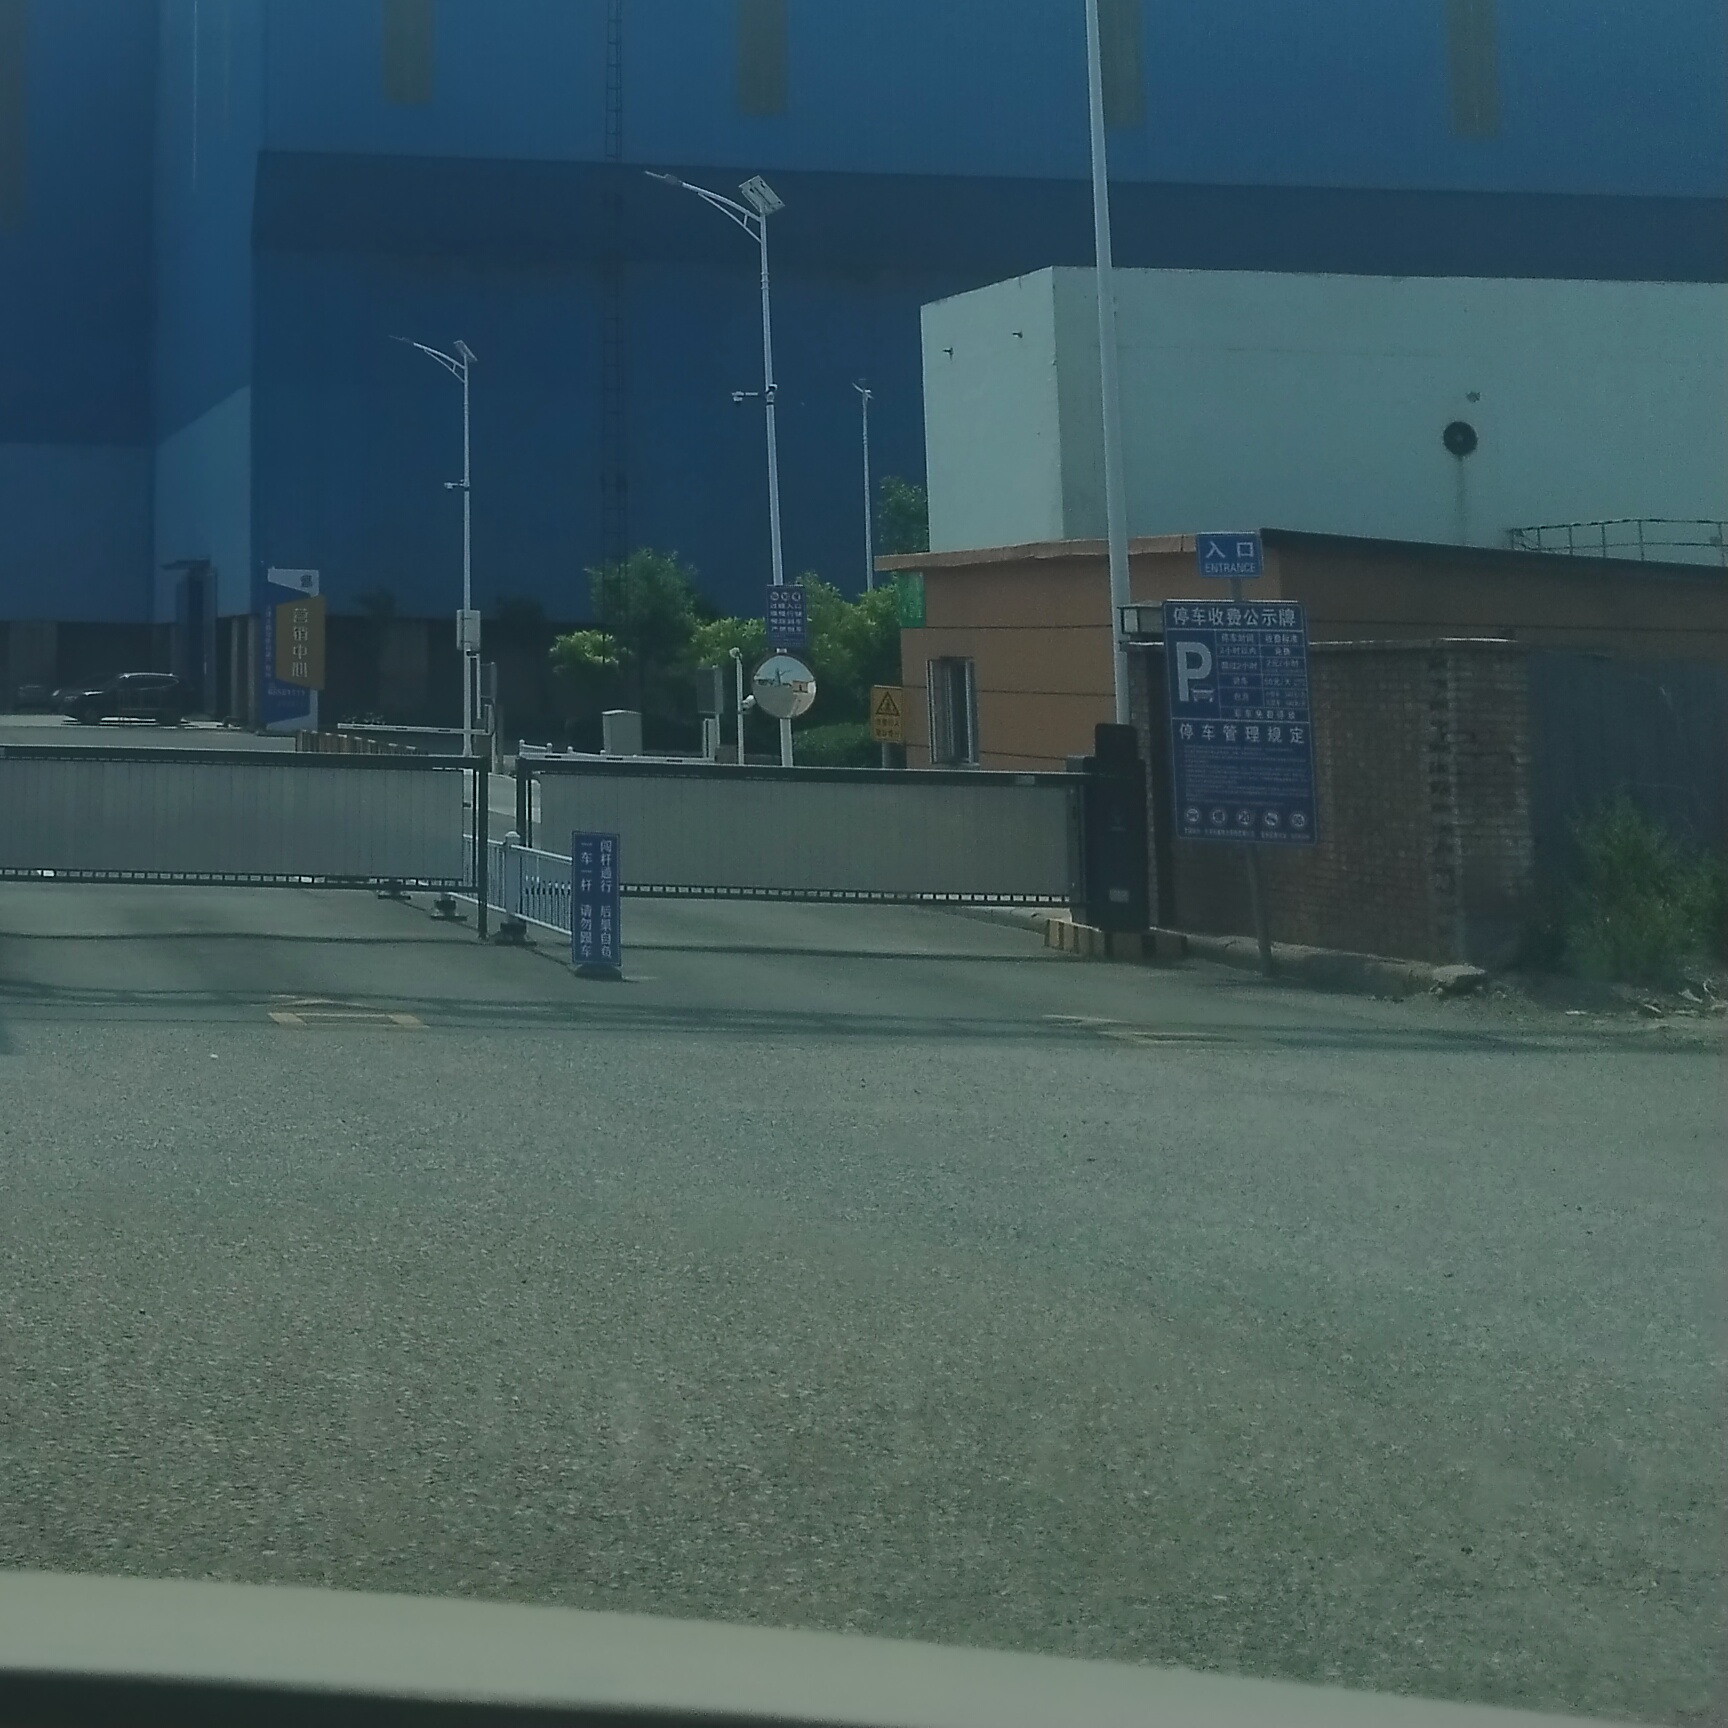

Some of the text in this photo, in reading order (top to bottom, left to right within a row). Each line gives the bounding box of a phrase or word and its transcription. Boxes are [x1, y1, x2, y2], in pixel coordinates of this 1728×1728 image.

[1205, 541, 1254, 558] 入口
[1205, 562, 1256, 573] ENTRANCE
[1173, 607, 1296, 627] 停车收费公示牌
[292, 608, 309, 678] 营销中心
[1176, 641, 1213, 702] P
[1179, 723, 1305, 744] 停车管理规定
[581, 841, 593, 892] 一车一杆
